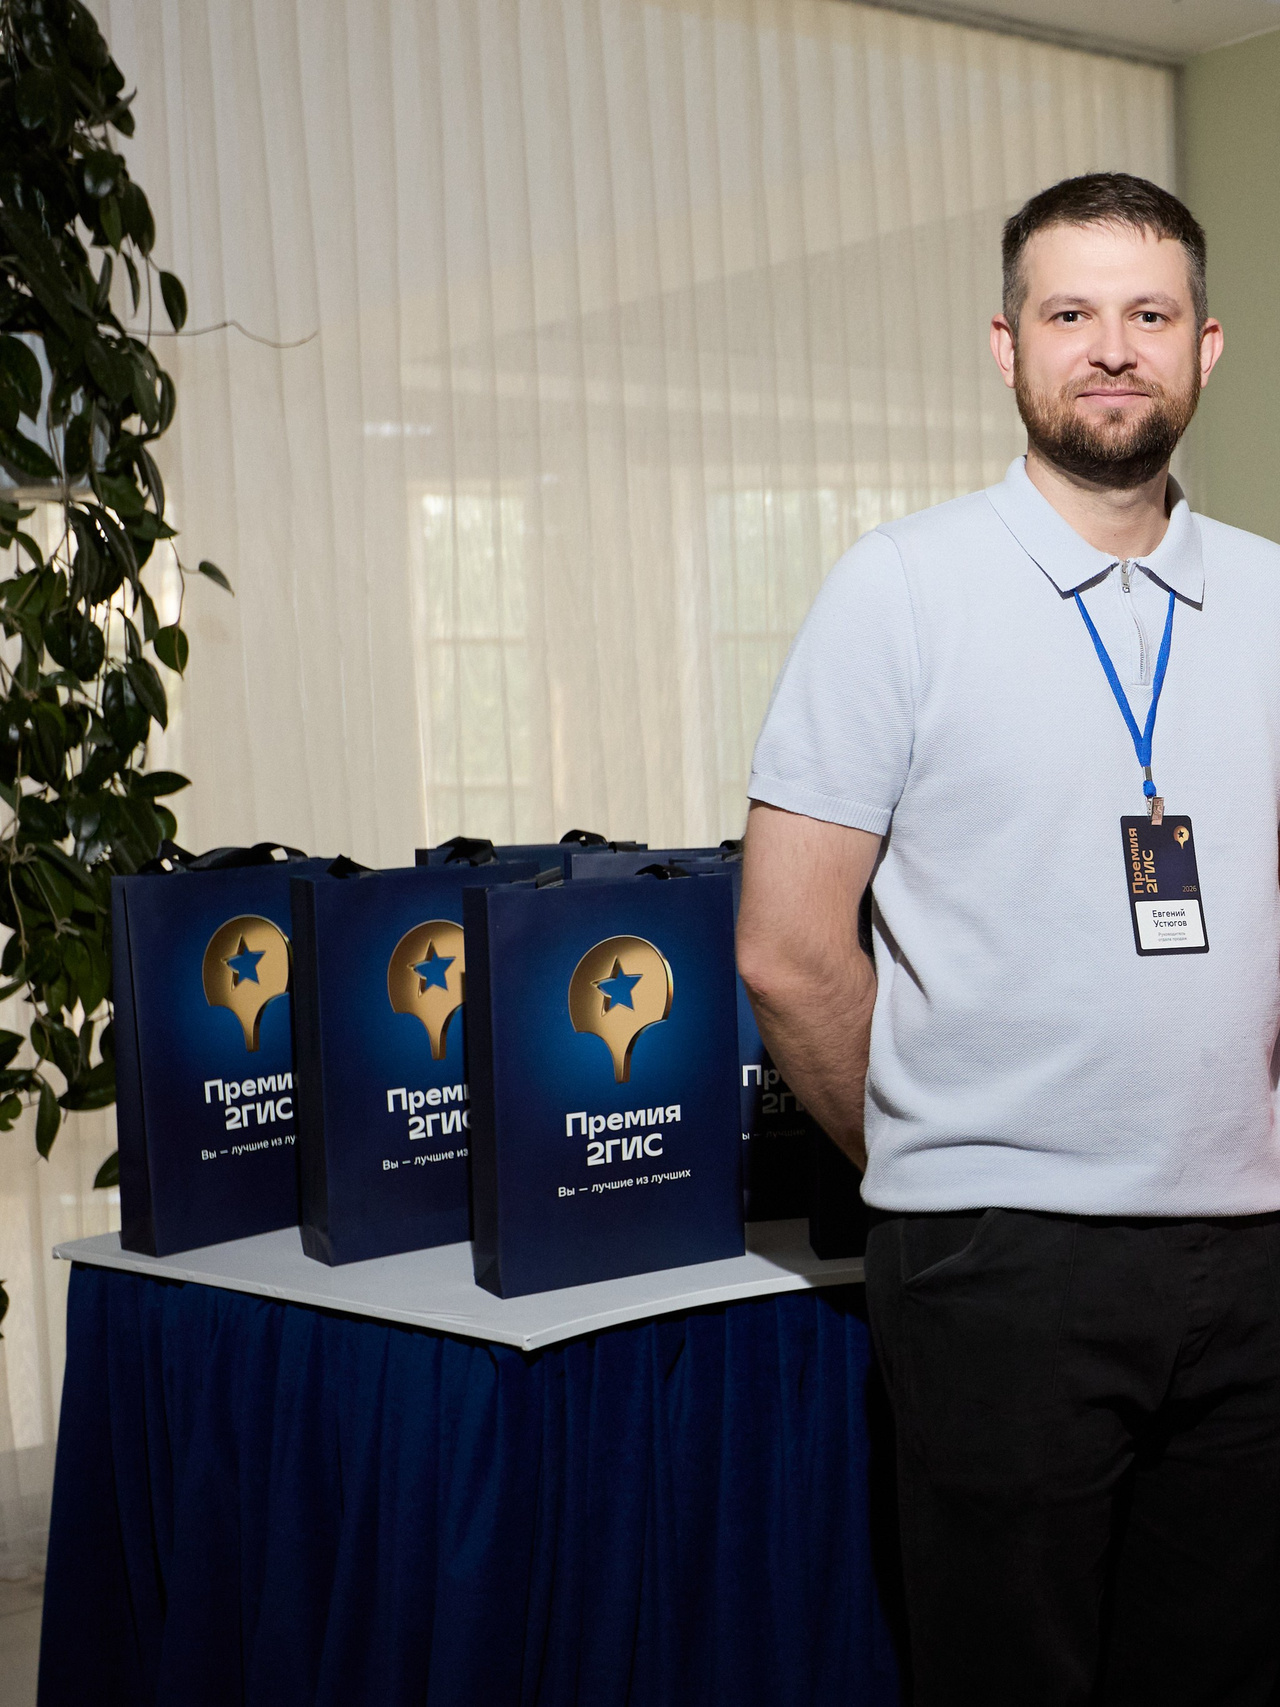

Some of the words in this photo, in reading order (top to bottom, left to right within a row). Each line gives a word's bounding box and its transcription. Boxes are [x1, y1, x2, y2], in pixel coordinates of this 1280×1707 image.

[1128, 827, 1146, 894] Премия
[1142, 849, 1159, 894] 2ГИС
[1152, 908, 1186, 918] Евгений
[1153, 919, 1188, 928] Устюгов
[203, 1071, 294, 1107] Преми
[224, 1096, 294, 1131] 2ГИС
[565, 1104, 682, 1141] Премия
[201, 1149, 217, 1161] Вы
[231, 1139, 270, 1156] лучшие
[271, 1136, 283, 1147] из
[382, 1159, 399, 1171] Вы
[413, 1150, 455, 1166] лучшие
[456, 1147, 469, 1158] из
[586, 1132, 664, 1167] 2ГИС
[558, 1186, 576, 1198] Вы
[591, 1178, 634, 1194] лучшие
[636, 1175, 649, 1186] из
[650, 1169, 691, 1185] лучших
